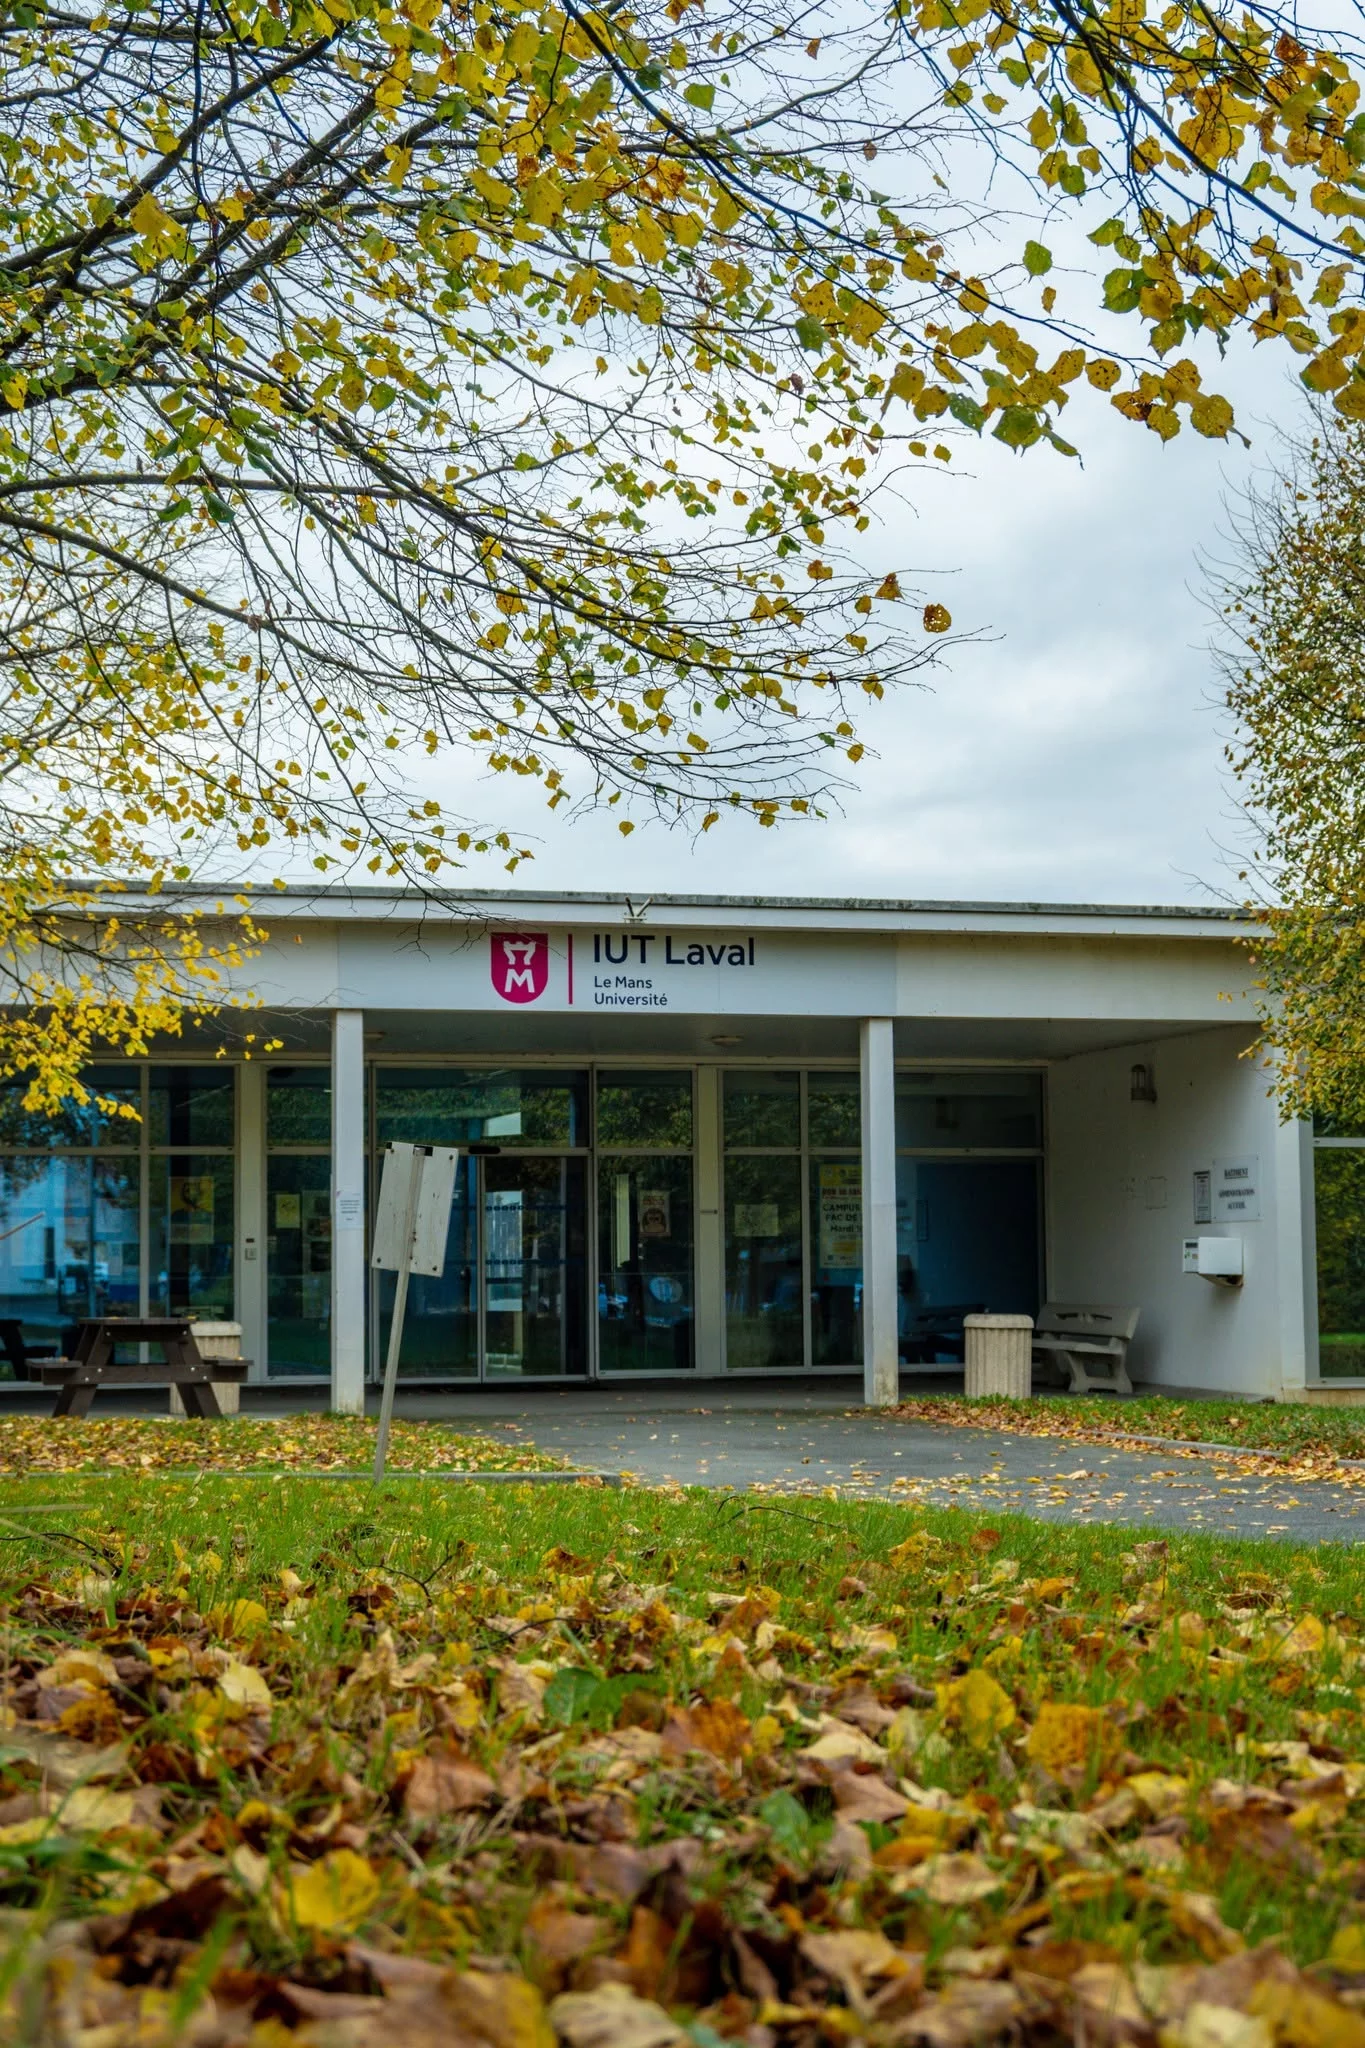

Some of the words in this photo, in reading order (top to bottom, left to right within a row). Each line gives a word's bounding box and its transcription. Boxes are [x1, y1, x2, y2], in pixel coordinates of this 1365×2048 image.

[594, 933, 656, 964] IUT
[665, 935, 755, 966] Laval
[594, 975, 613, 989] Le
[615, 976, 652, 989] Mans
[594, 992, 668, 1006] Université
